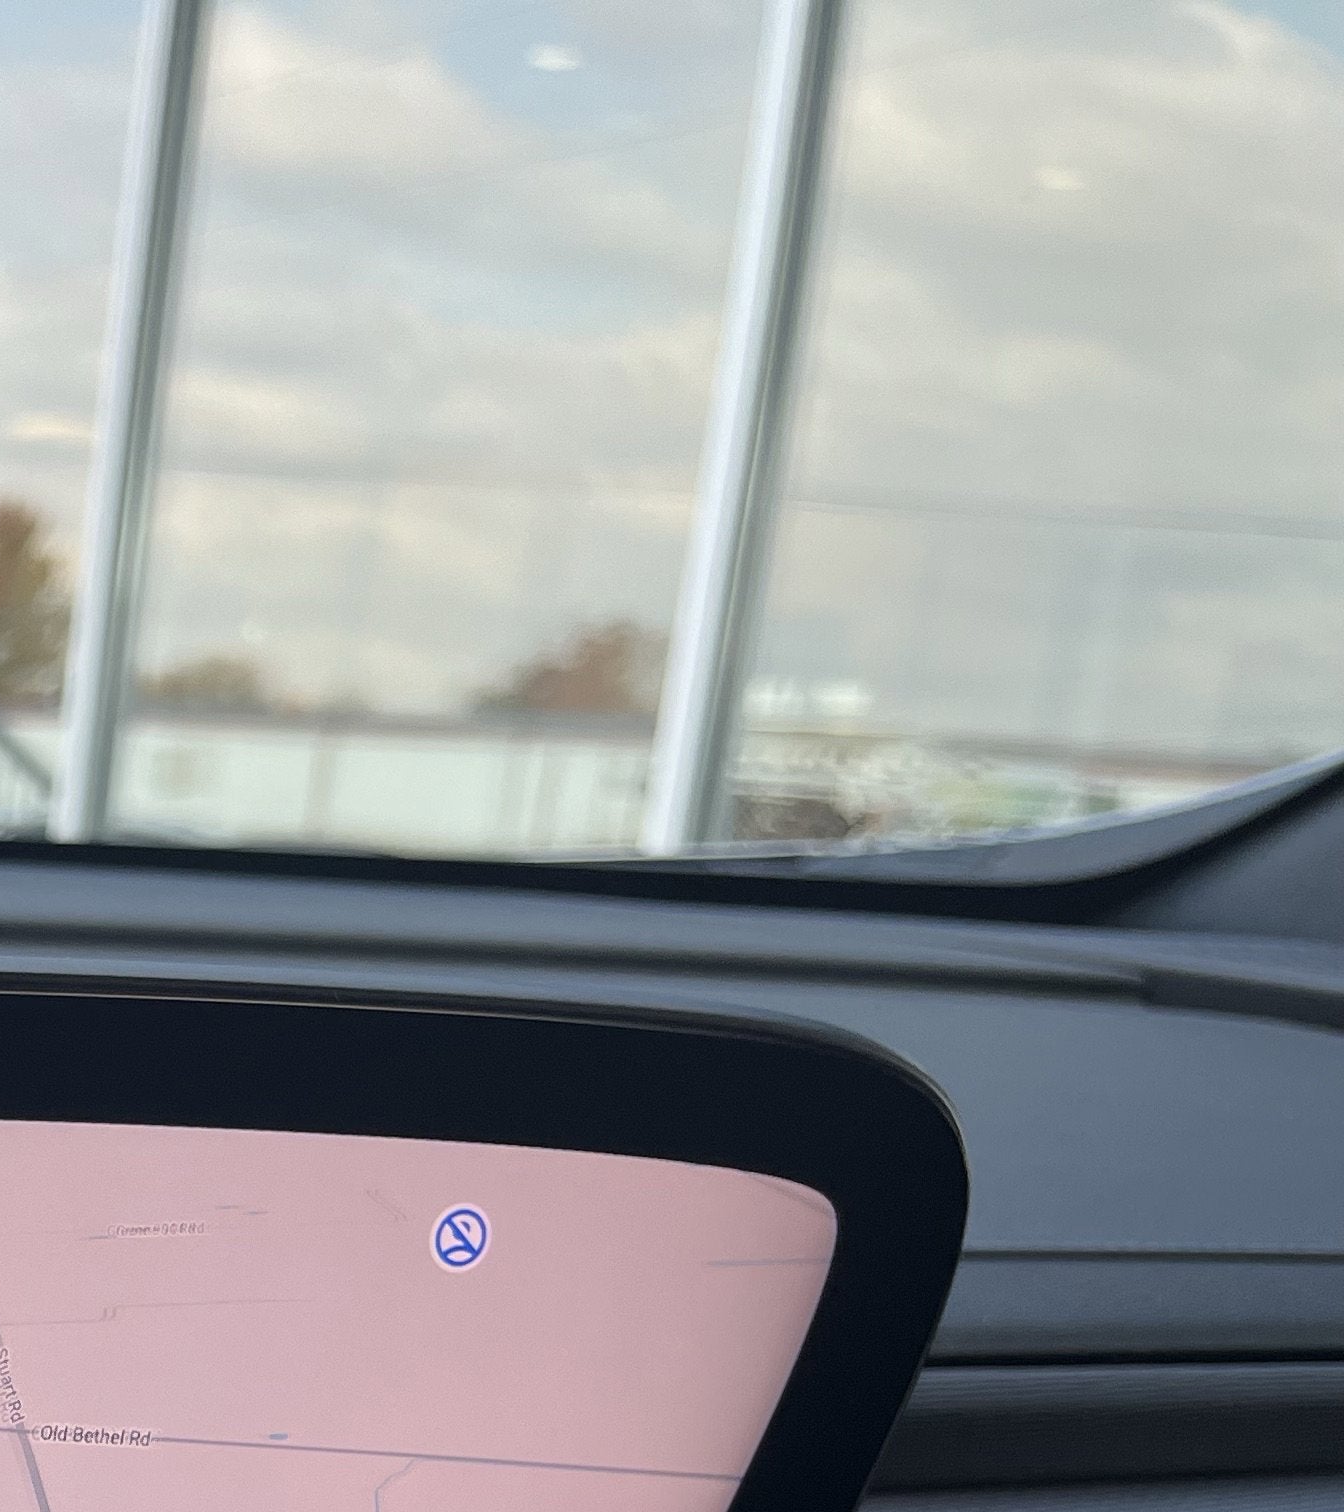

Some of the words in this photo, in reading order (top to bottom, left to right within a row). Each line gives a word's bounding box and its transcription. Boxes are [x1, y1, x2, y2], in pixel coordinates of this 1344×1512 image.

[40, 1425, 68, 1442] Old
[73, 1427, 126, 1445] Bethel
[128, 1429, 151, 1446] Rd
